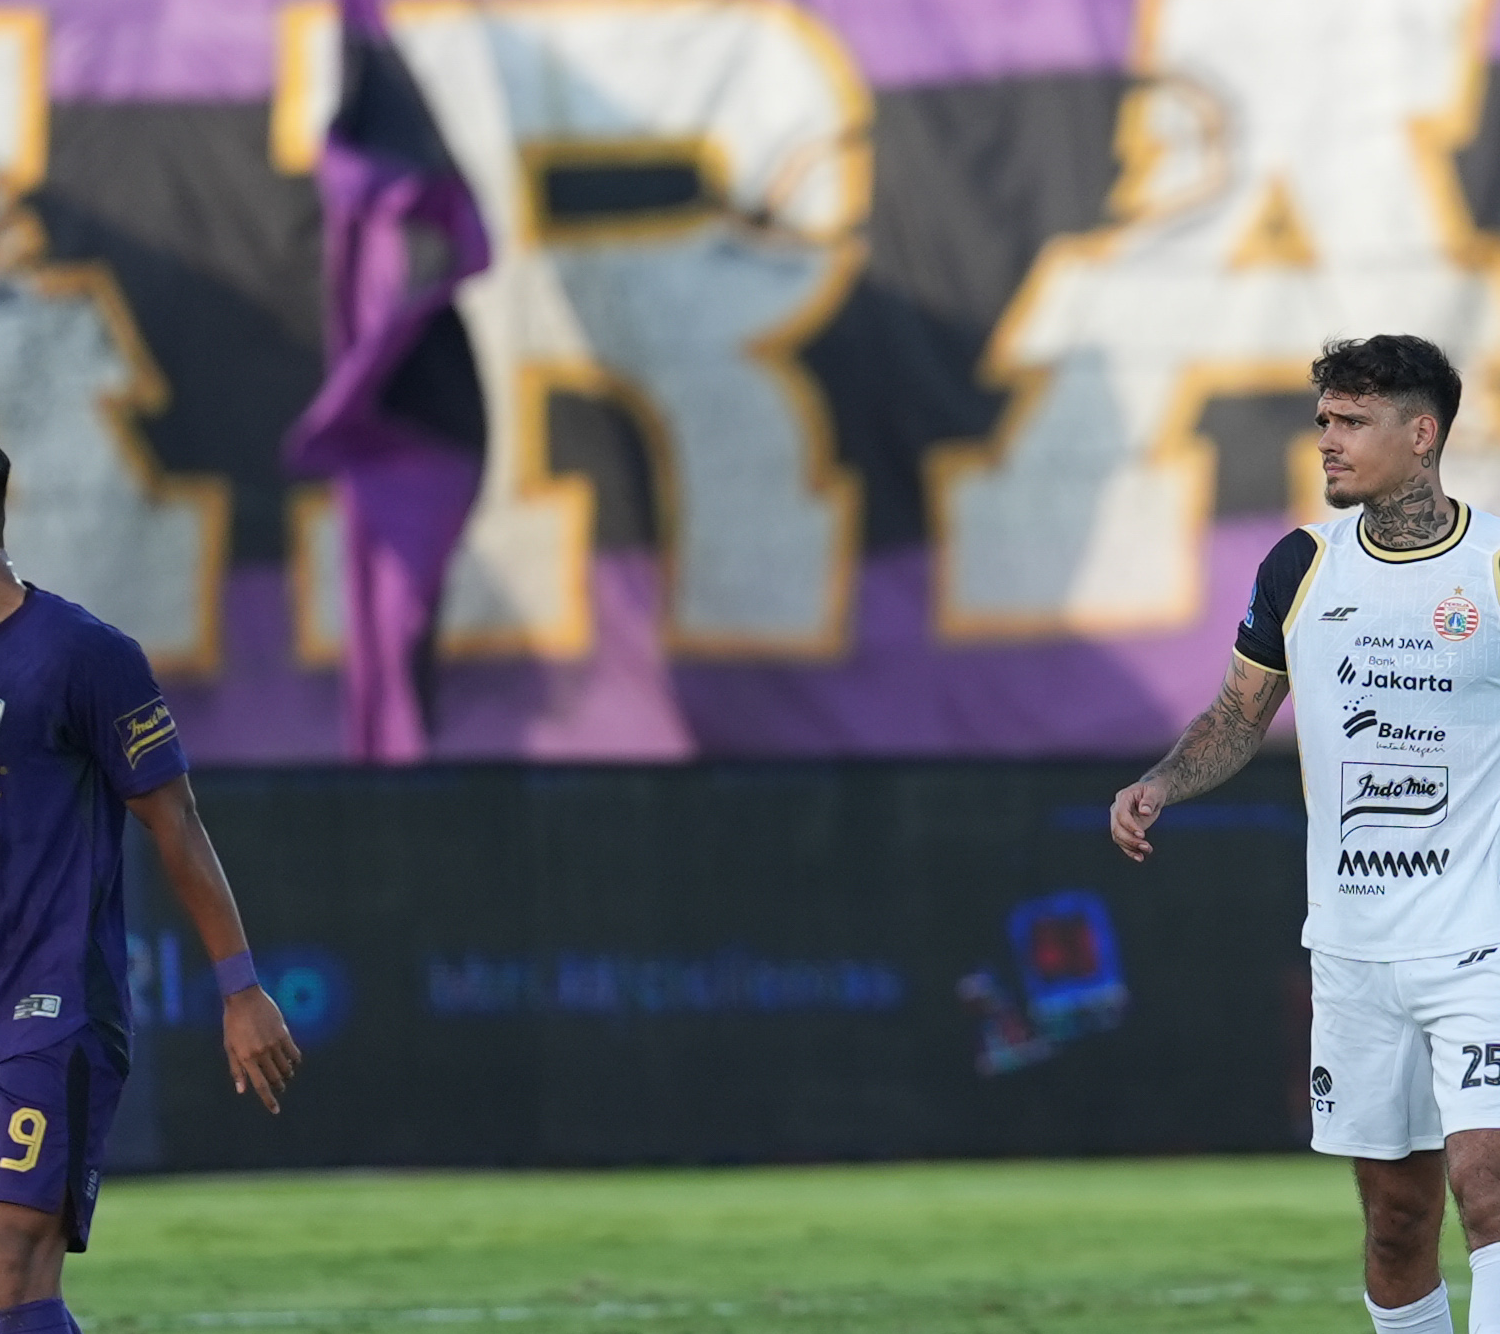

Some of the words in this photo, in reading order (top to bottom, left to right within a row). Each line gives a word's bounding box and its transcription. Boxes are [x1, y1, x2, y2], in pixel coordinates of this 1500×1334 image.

[1362, 636, 1394, 648] PAM
[1397, 638, 1434, 650] JAYA
[1368, 655, 1396, 667] Bank
[1361, 669, 1453, 693] Jakarta
[1377, 722, 1446, 742] Bakrie
[1338, 882, 1385, 896] AMMAN
